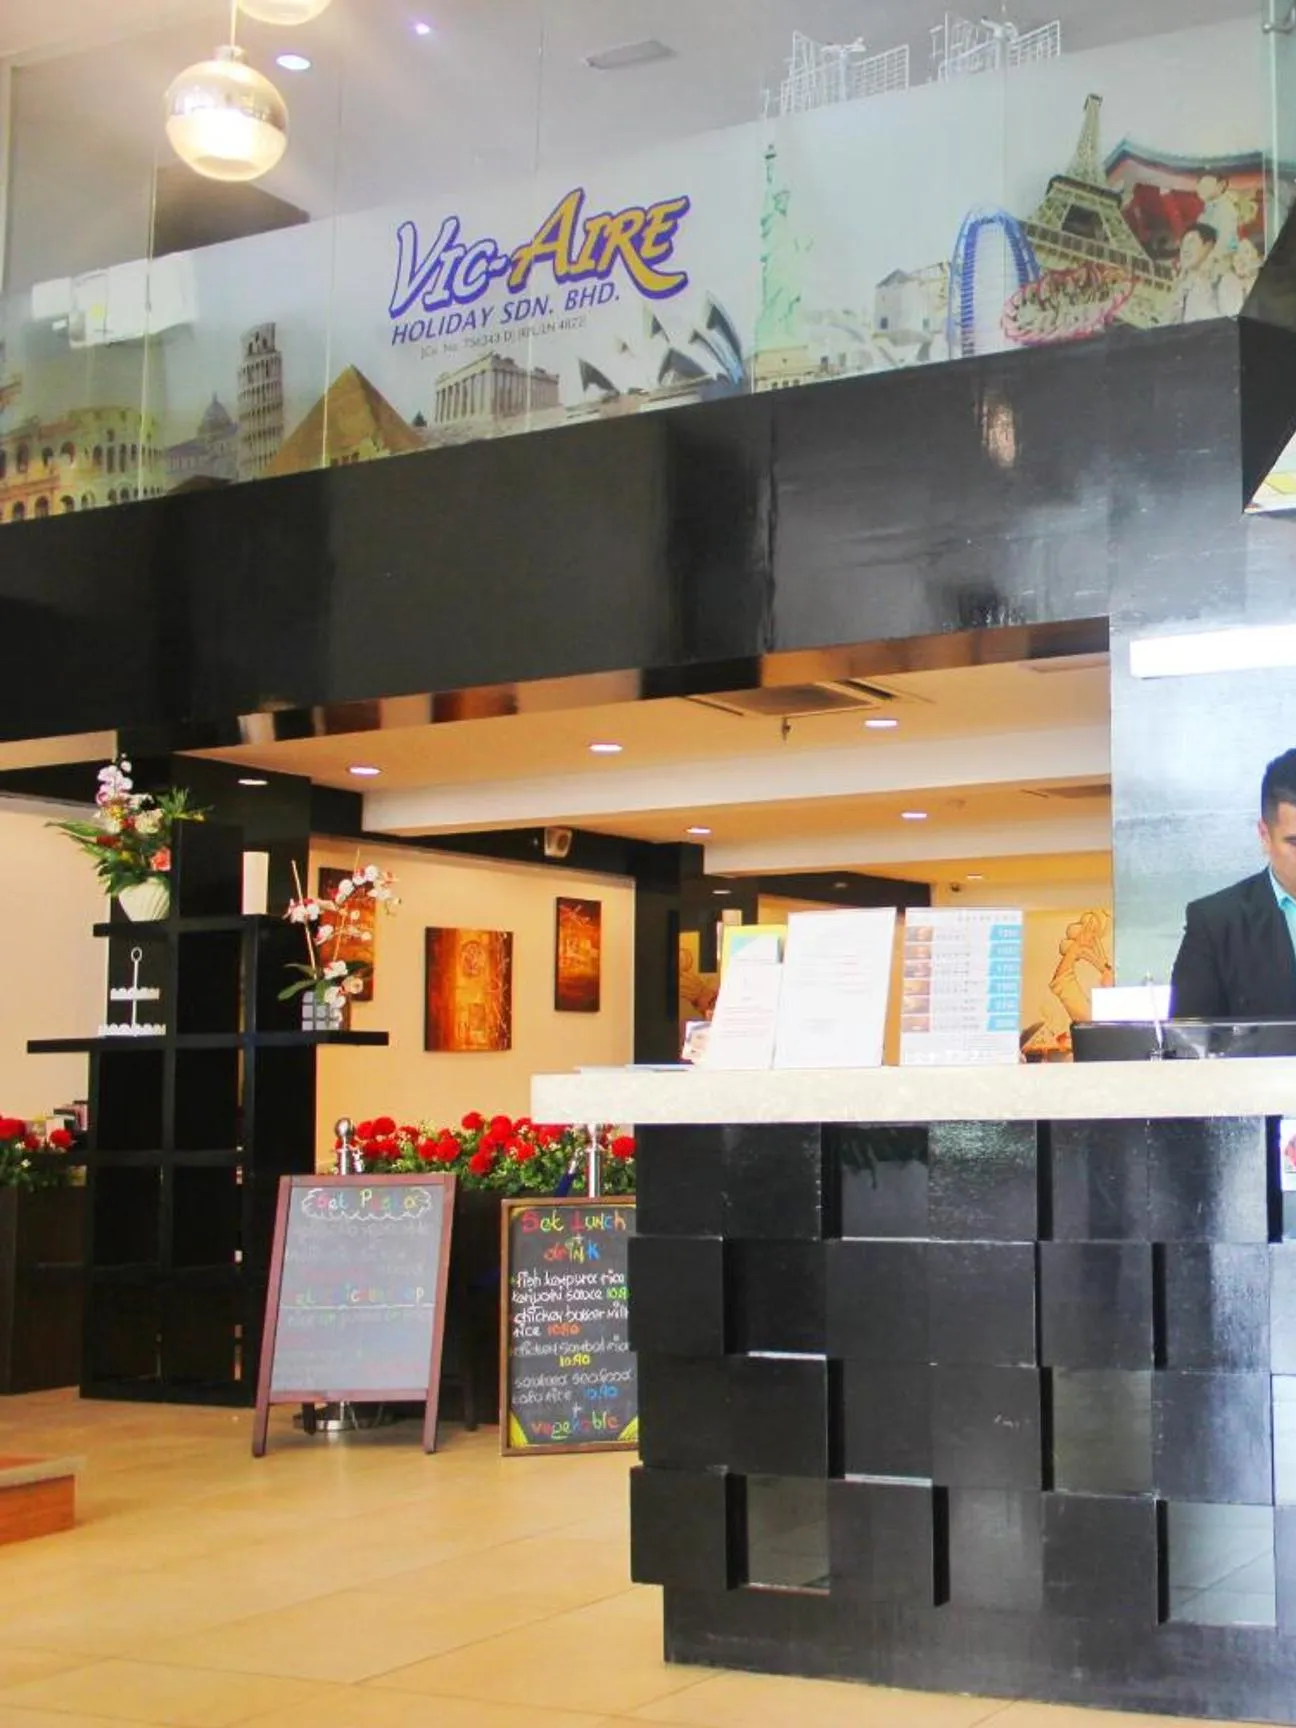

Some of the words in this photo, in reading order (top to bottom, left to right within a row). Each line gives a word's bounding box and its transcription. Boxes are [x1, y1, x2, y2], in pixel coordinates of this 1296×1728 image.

[391, 306, 495, 346] HOLIDAY
[500, 296, 554, 325] SDN.
[564, 281, 621, 312] BHD.
[521, 1208, 565, 1233] Set
